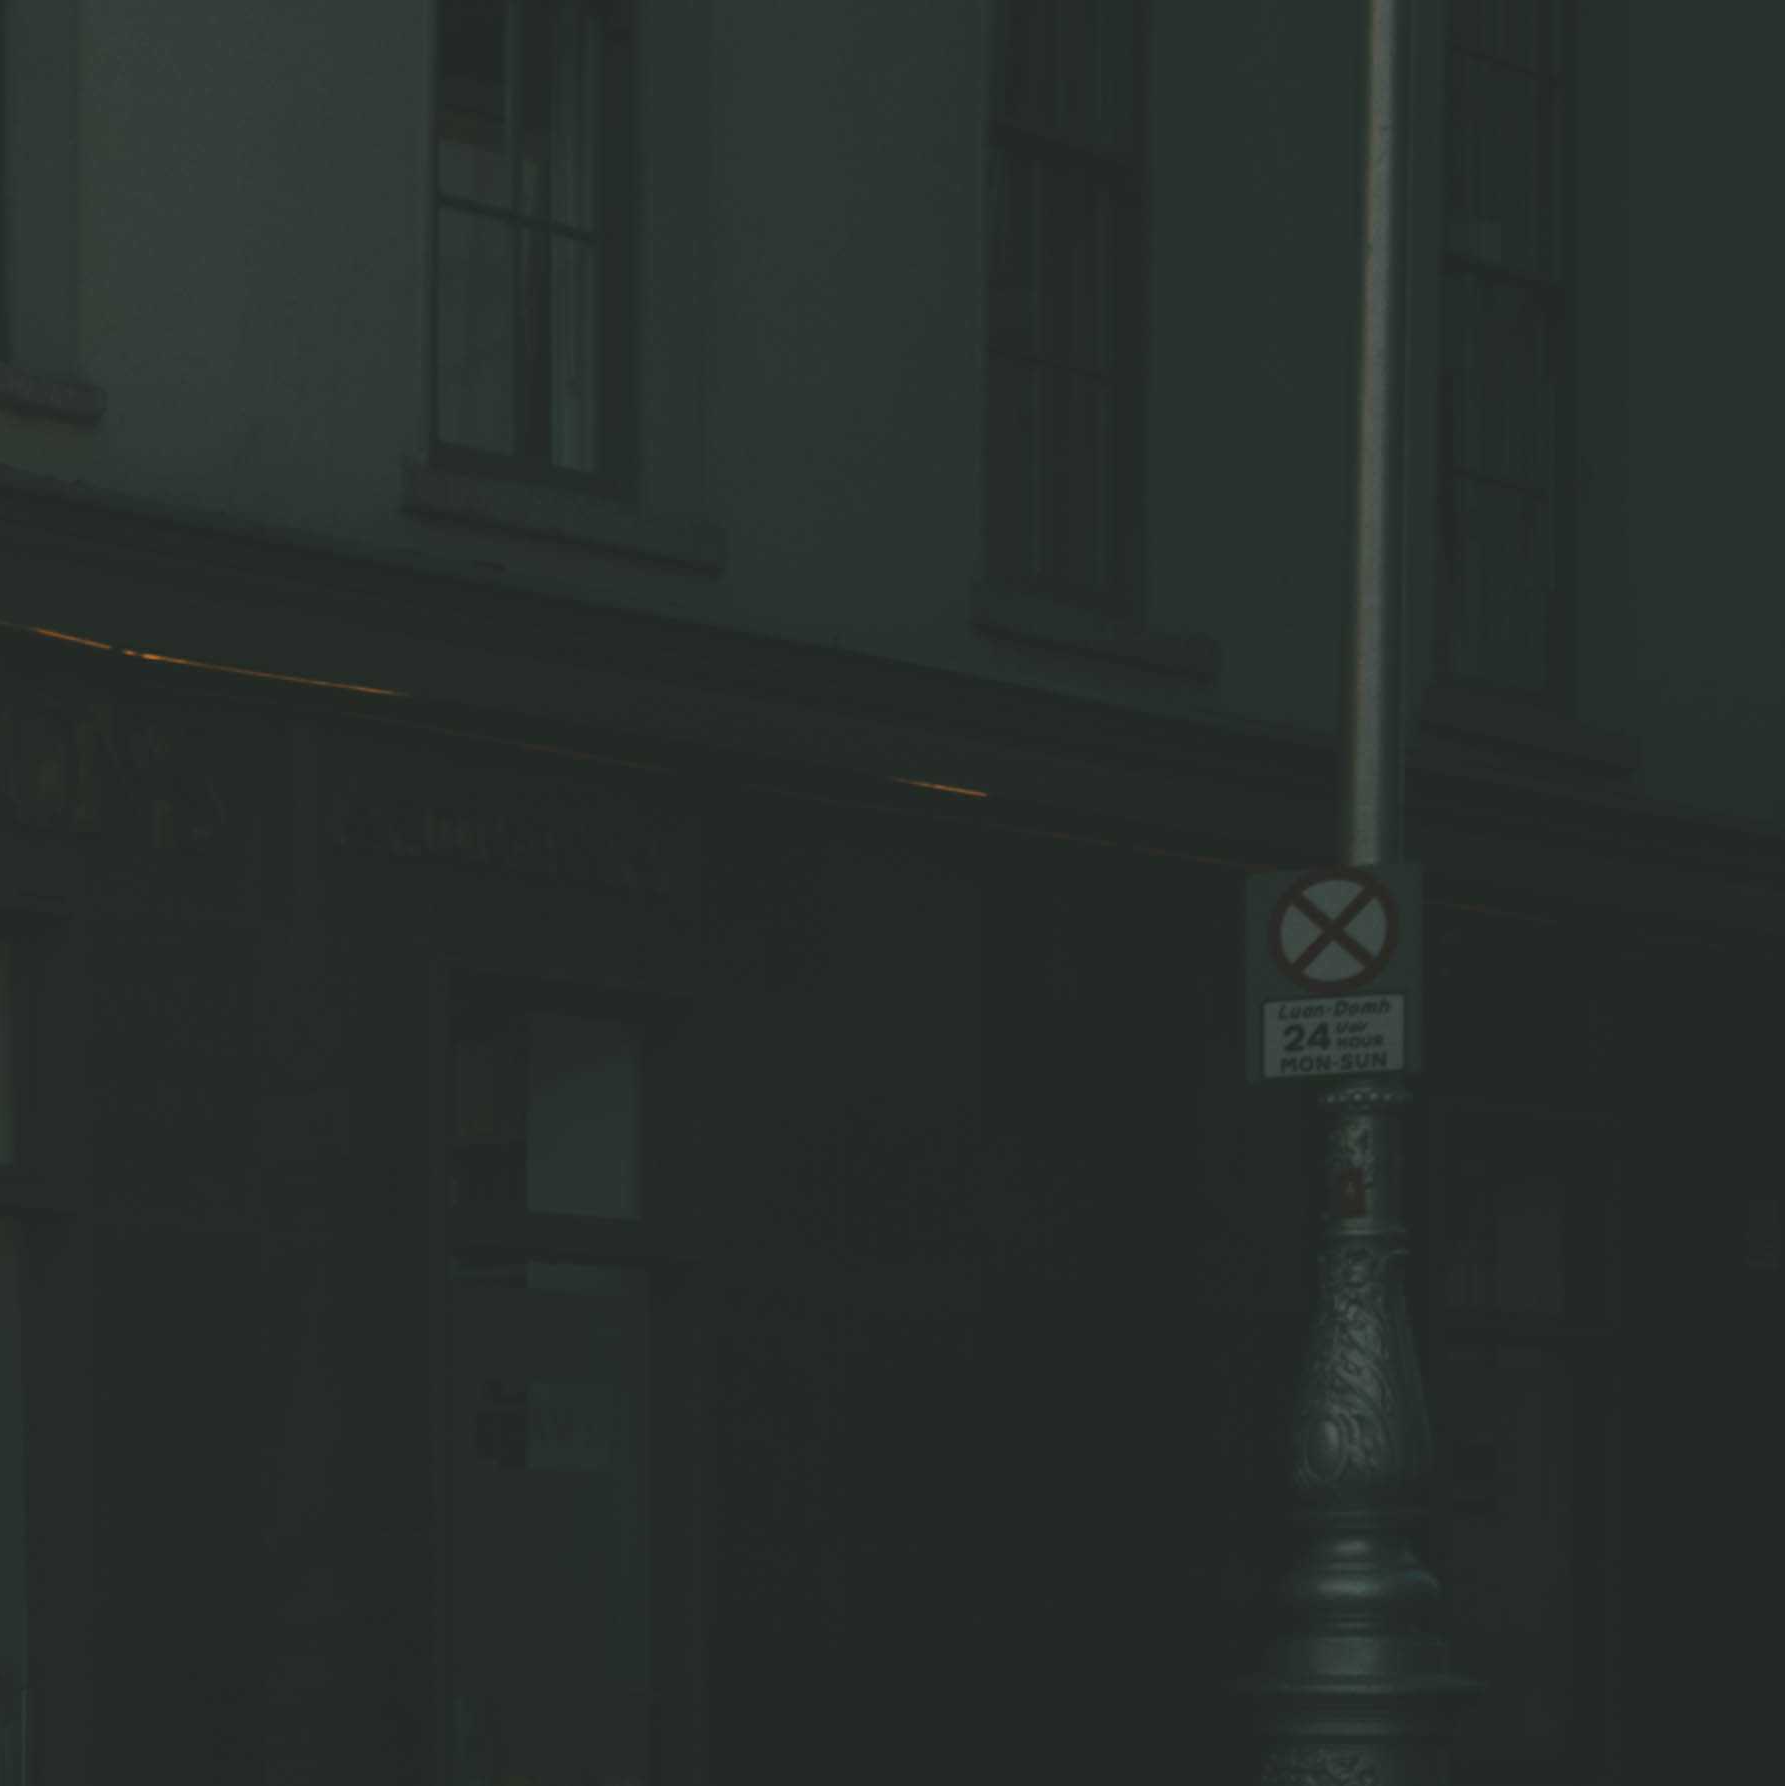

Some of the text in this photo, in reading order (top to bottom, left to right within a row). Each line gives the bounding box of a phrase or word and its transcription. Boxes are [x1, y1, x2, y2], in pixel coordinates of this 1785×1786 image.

[1282, 1022, 1331, 1052] 24
[1335, 1034, 1384, 1048] HOUR
[1279, 1052, 1388, 1073] MON-SUN
